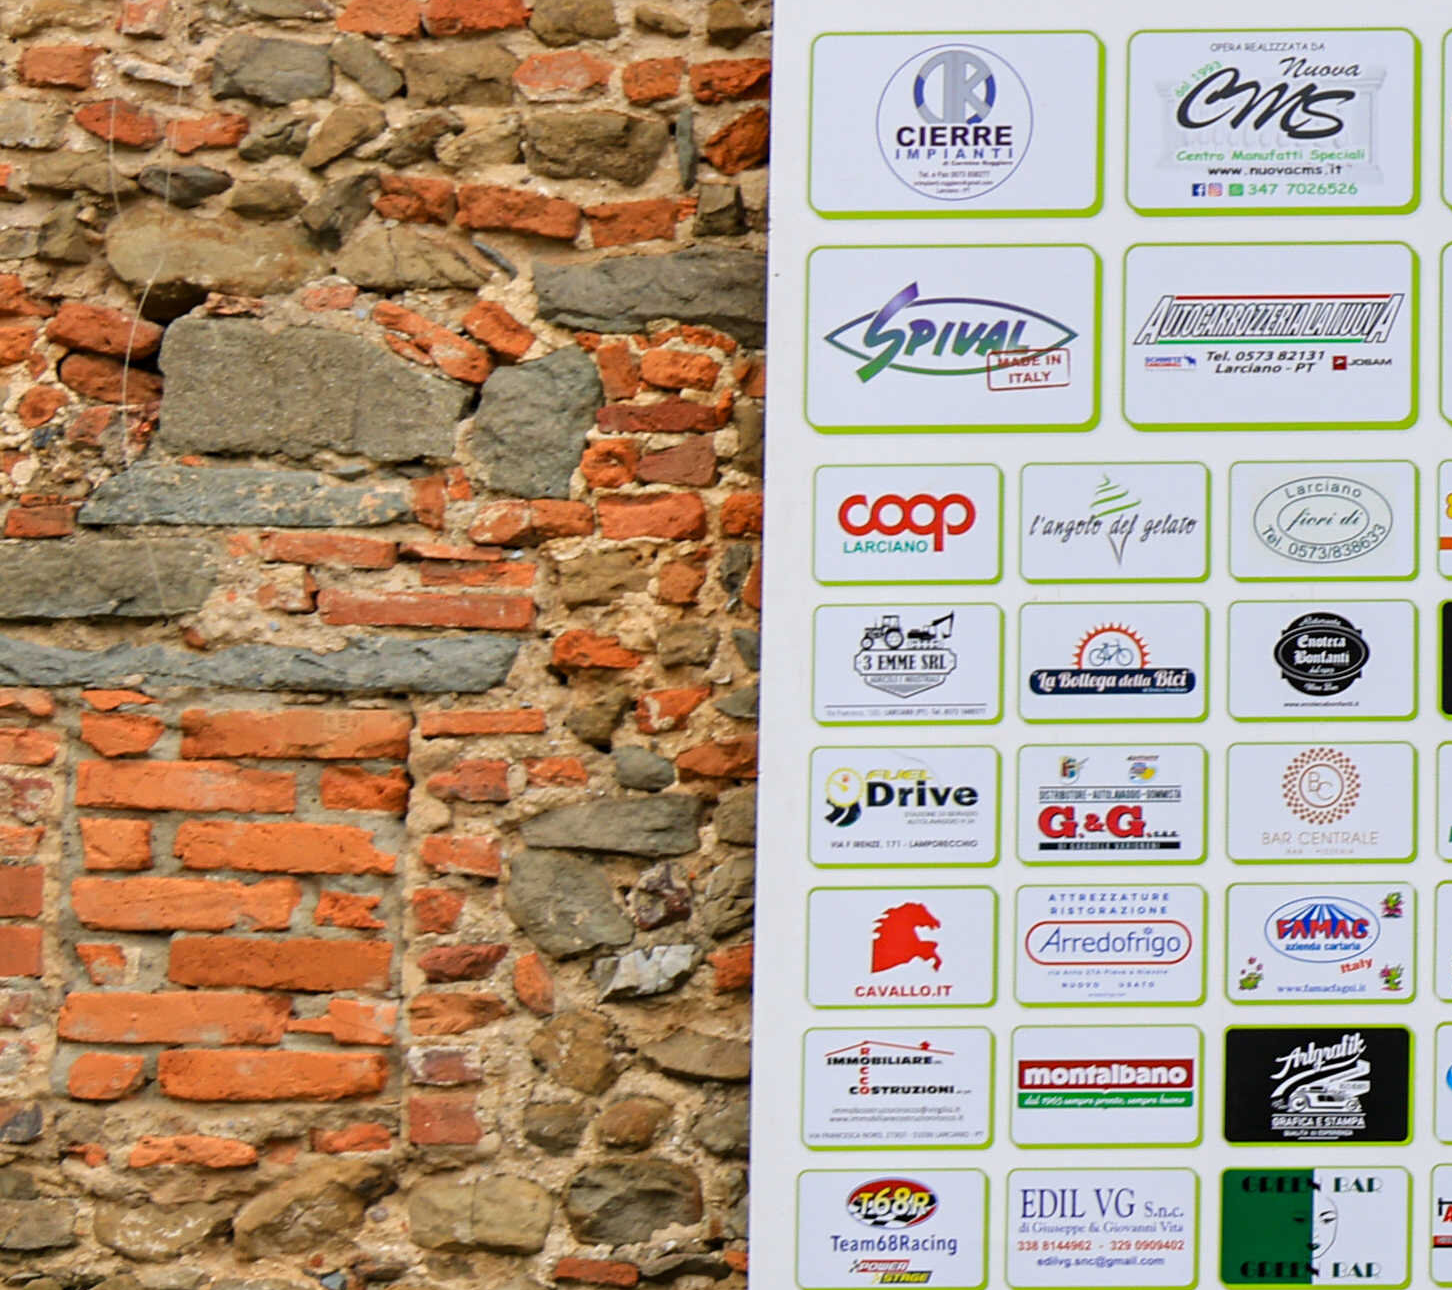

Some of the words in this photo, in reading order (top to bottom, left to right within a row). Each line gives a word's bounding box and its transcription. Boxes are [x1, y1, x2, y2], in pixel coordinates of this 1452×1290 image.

[1280, 57, 1360, 78] Nuova
[896, 126, 1012, 146] CIERRE
[896, 148, 1013, 159] IMPIANTI
[1176, 150, 1224, 162] Centro
[1232, 150, 1303, 161] Manufatti
[1310, 149, 1365, 162] Speciali
[1248, 183, 1278, 195] 347
[1286, 182, 1358, 195] 7026526
[998, 356, 1040, 369] MADE
[1046, 354, 1062, 366] IN
[1236, 351, 1275, 361] 0573
[1215, 362, 1282, 373] Larciano
[1294, 362, 1315, 373] PT
[1008, 371, 1052, 384] ITALY
[1285, 480, 1362, 499] Larciano
[838, 493, 976, 552] coop
[1142, 514, 1196, 541] gelato
[1286, 508, 1334, 531] fiori
[843, 540, 928, 554] LARCIANO
[1289, 523, 1386, 559] 0573/838633
[877, 654, 917, 671] EMME
[920, 654, 947, 670] SRL
[1153, 669, 1187, 687] Bici
[867, 781, 979, 807] Drive
[1262, 832, 1292, 845] BAR
[1298, 831, 1379, 845] CENTRALE
[1048, 893, 1169, 902] ATTREZZATURE
[1277, 918, 1369, 939] FAMAC
[1039, 926, 1181, 957] Arredofrigo
[1340, 958, 1373, 974] Italy
[855, 984, 953, 998] CAVALLO.IT
[827, 1057, 932, 1065] IMMOBILIARE
[1024, 1064, 1187, 1085] montalbano
[850, 1085, 954, 1095] COSTRUZIONI
[1241, 1177, 1321, 1193] GREEN
[1333, 1176, 1382, 1192] BAR
[857, 1188, 930, 1216] T68R
[1021, 1189, 1086, 1218] EDIL
[1094, 1188, 1135, 1218] VG
[1144, 1201, 1184, 1217] S.n.c.
[1032, 1222, 1084, 1235] Giuseppe
[1103, 1221, 1156, 1232] Giovanni
[830, 1234, 957, 1255] Team68Racing
[1240, 1262, 1319, 1278] GREEN
[1332, 1262, 1381, 1277] BAR
